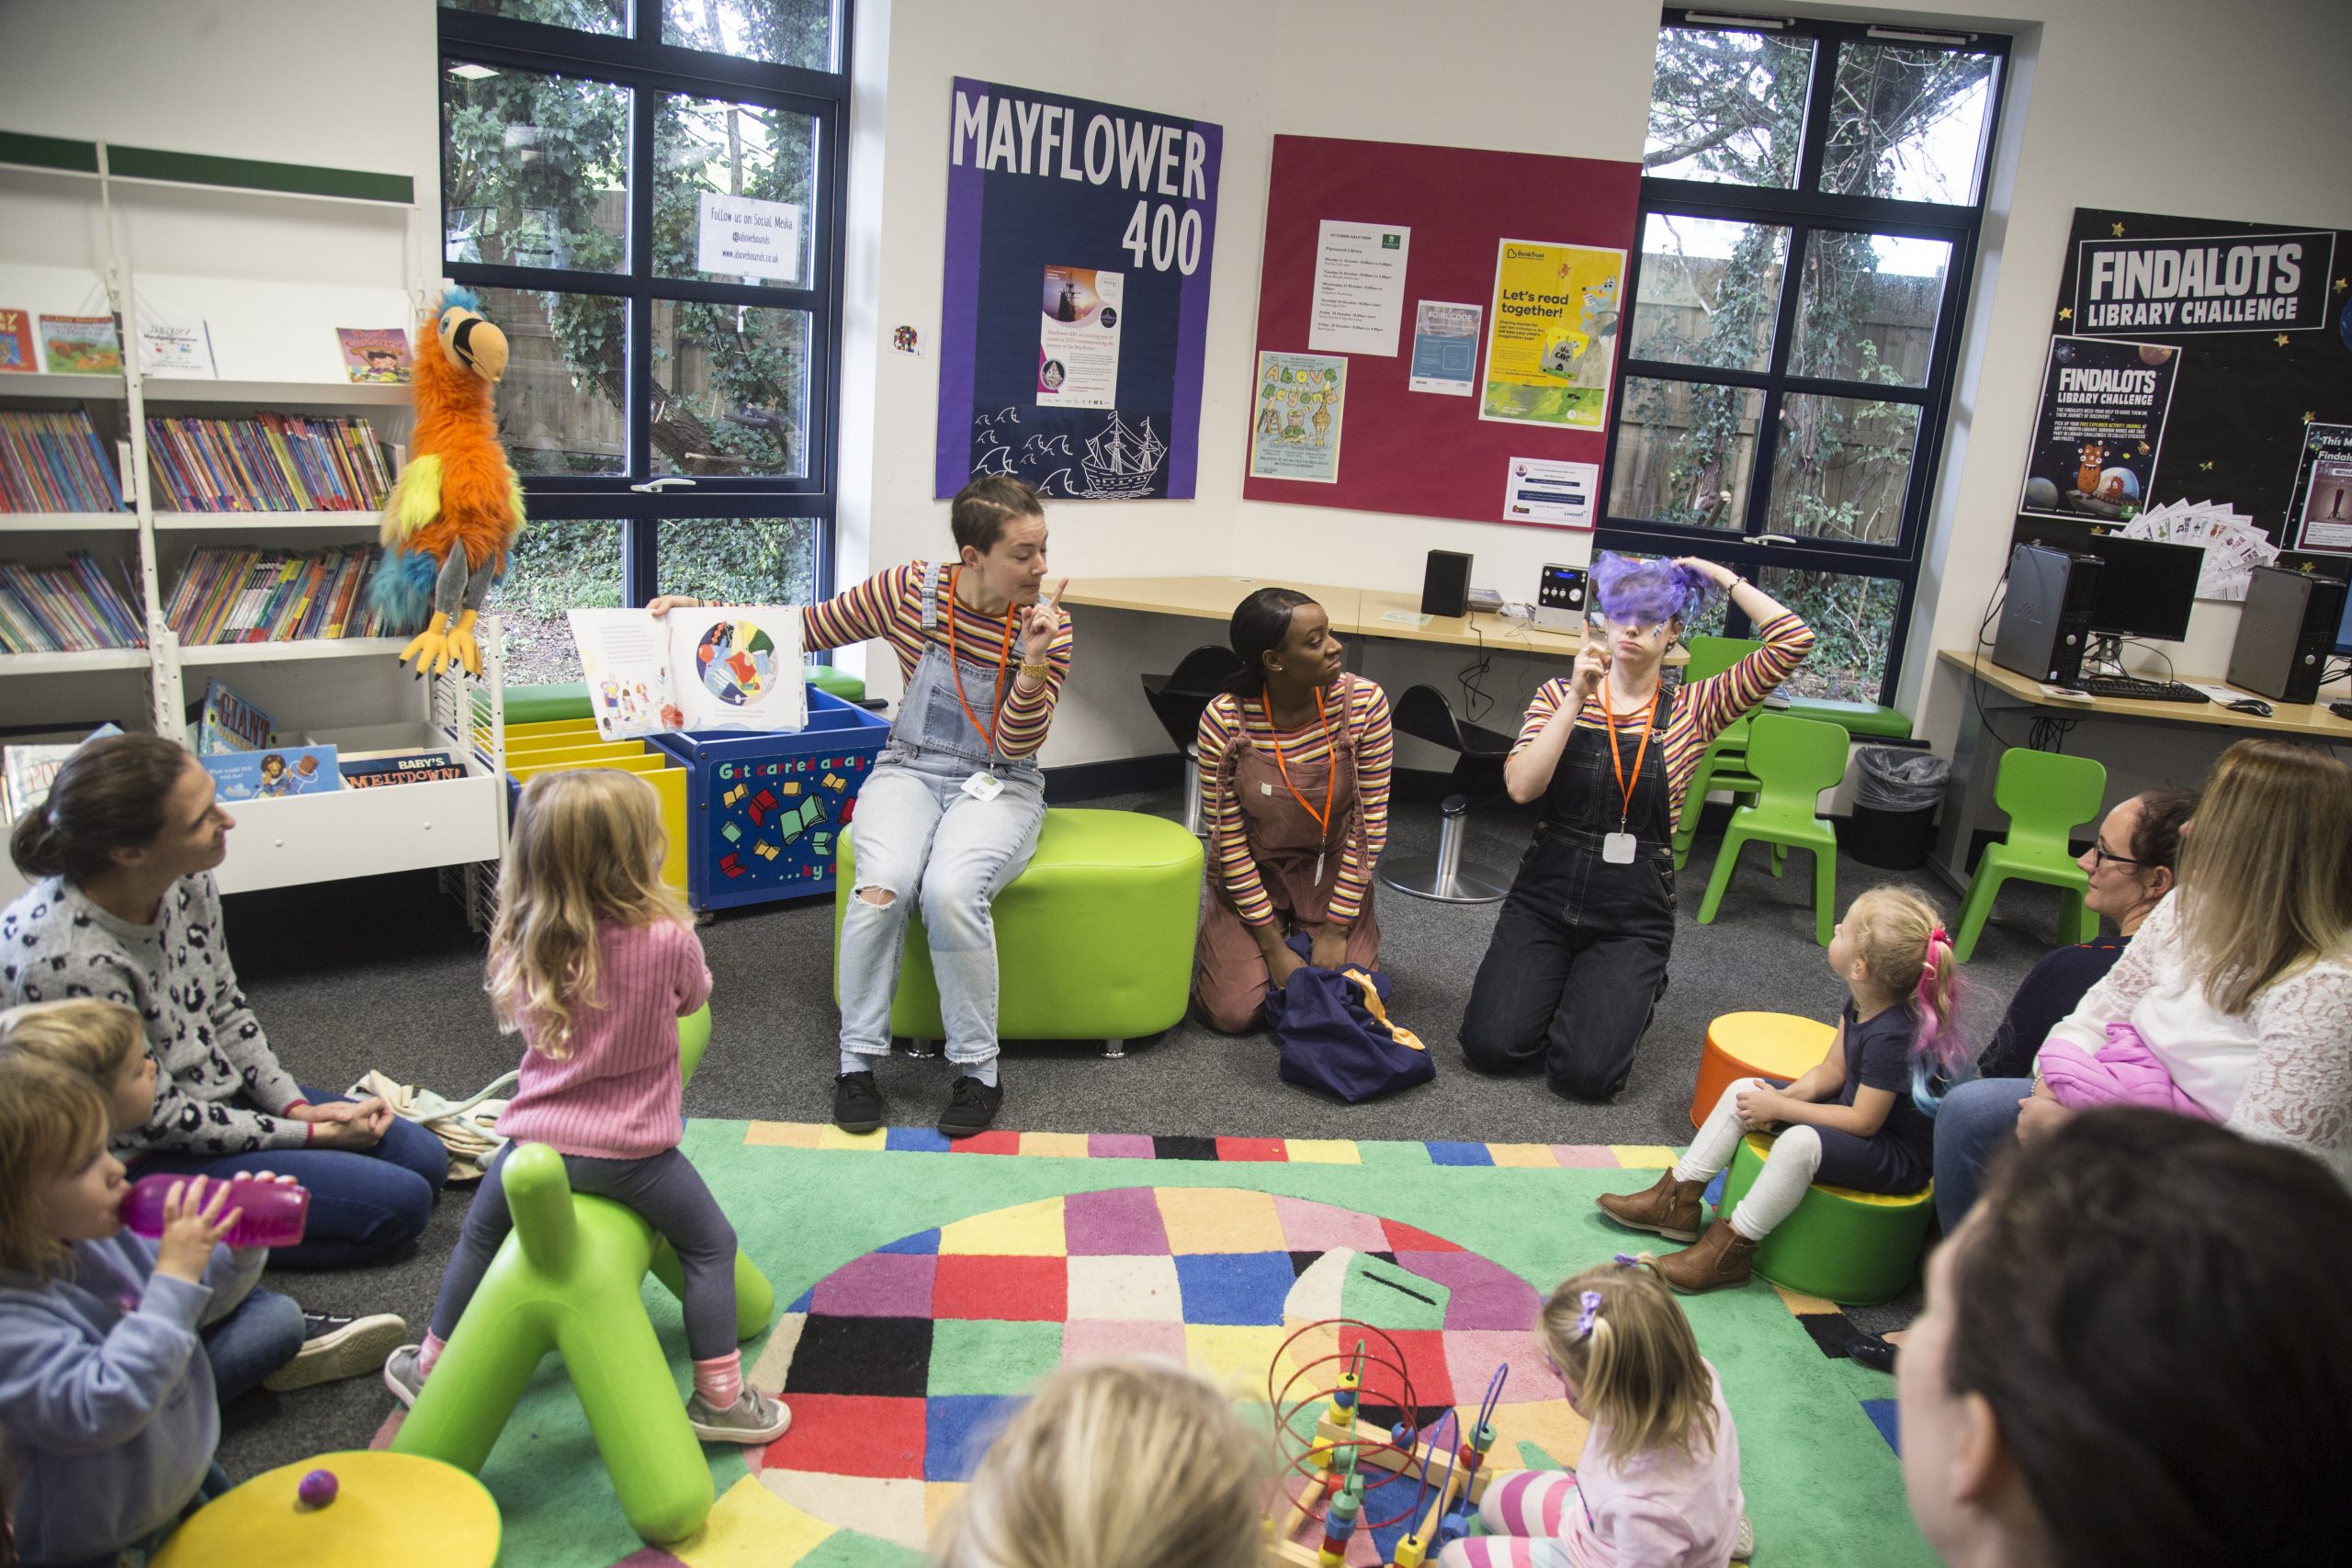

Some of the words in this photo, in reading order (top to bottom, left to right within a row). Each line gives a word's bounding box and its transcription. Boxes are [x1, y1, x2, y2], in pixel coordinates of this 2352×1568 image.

[953, 91, 1206, 200] MAYFLOWER
[711, 208, 731, 222] Follow
[735, 214, 741, 223] us
[744, 215, 752, 224] on
[754, 213, 772, 228] Social
[775, 217, 792, 230] Media
[732, 232, 770, 244] @abovebounds
[1122, 199, 1202, 276] 400
[722, 250, 778, 264] www.abovebounds.co.uk
[2090, 243, 2302, 300] FINDALOTS
[1503, 289, 1534, 302] Let's
[1538, 294, 1568, 305] read
[1428, 311, 1473, 321] #GIRLCODE
[1501, 302, 1563, 318] together!
[2088, 301, 2177, 327] LIBRARY
[2181, 297, 2298, 324] CHALLENGE
[1555, 352, 1571, 362] CAVE
[1264, 362, 1338, 384] Above
[2059, 367, 2156, 393] FINDALOTS
[1261, 383, 1338, 408] Beyond
[2057, 392, 2098, 404] LIBRARY
[2100, 394, 2154, 405] CHALLENGE
[2323, 435, 2342, 446] This
[219, 692, 270, 750] GIANT
[398, 757, 445, 770] BABY'S
[719, 763, 752, 779] Get
[756, 756, 816, 777] carried
[347, 768, 460, 789] MELTDOWN!
